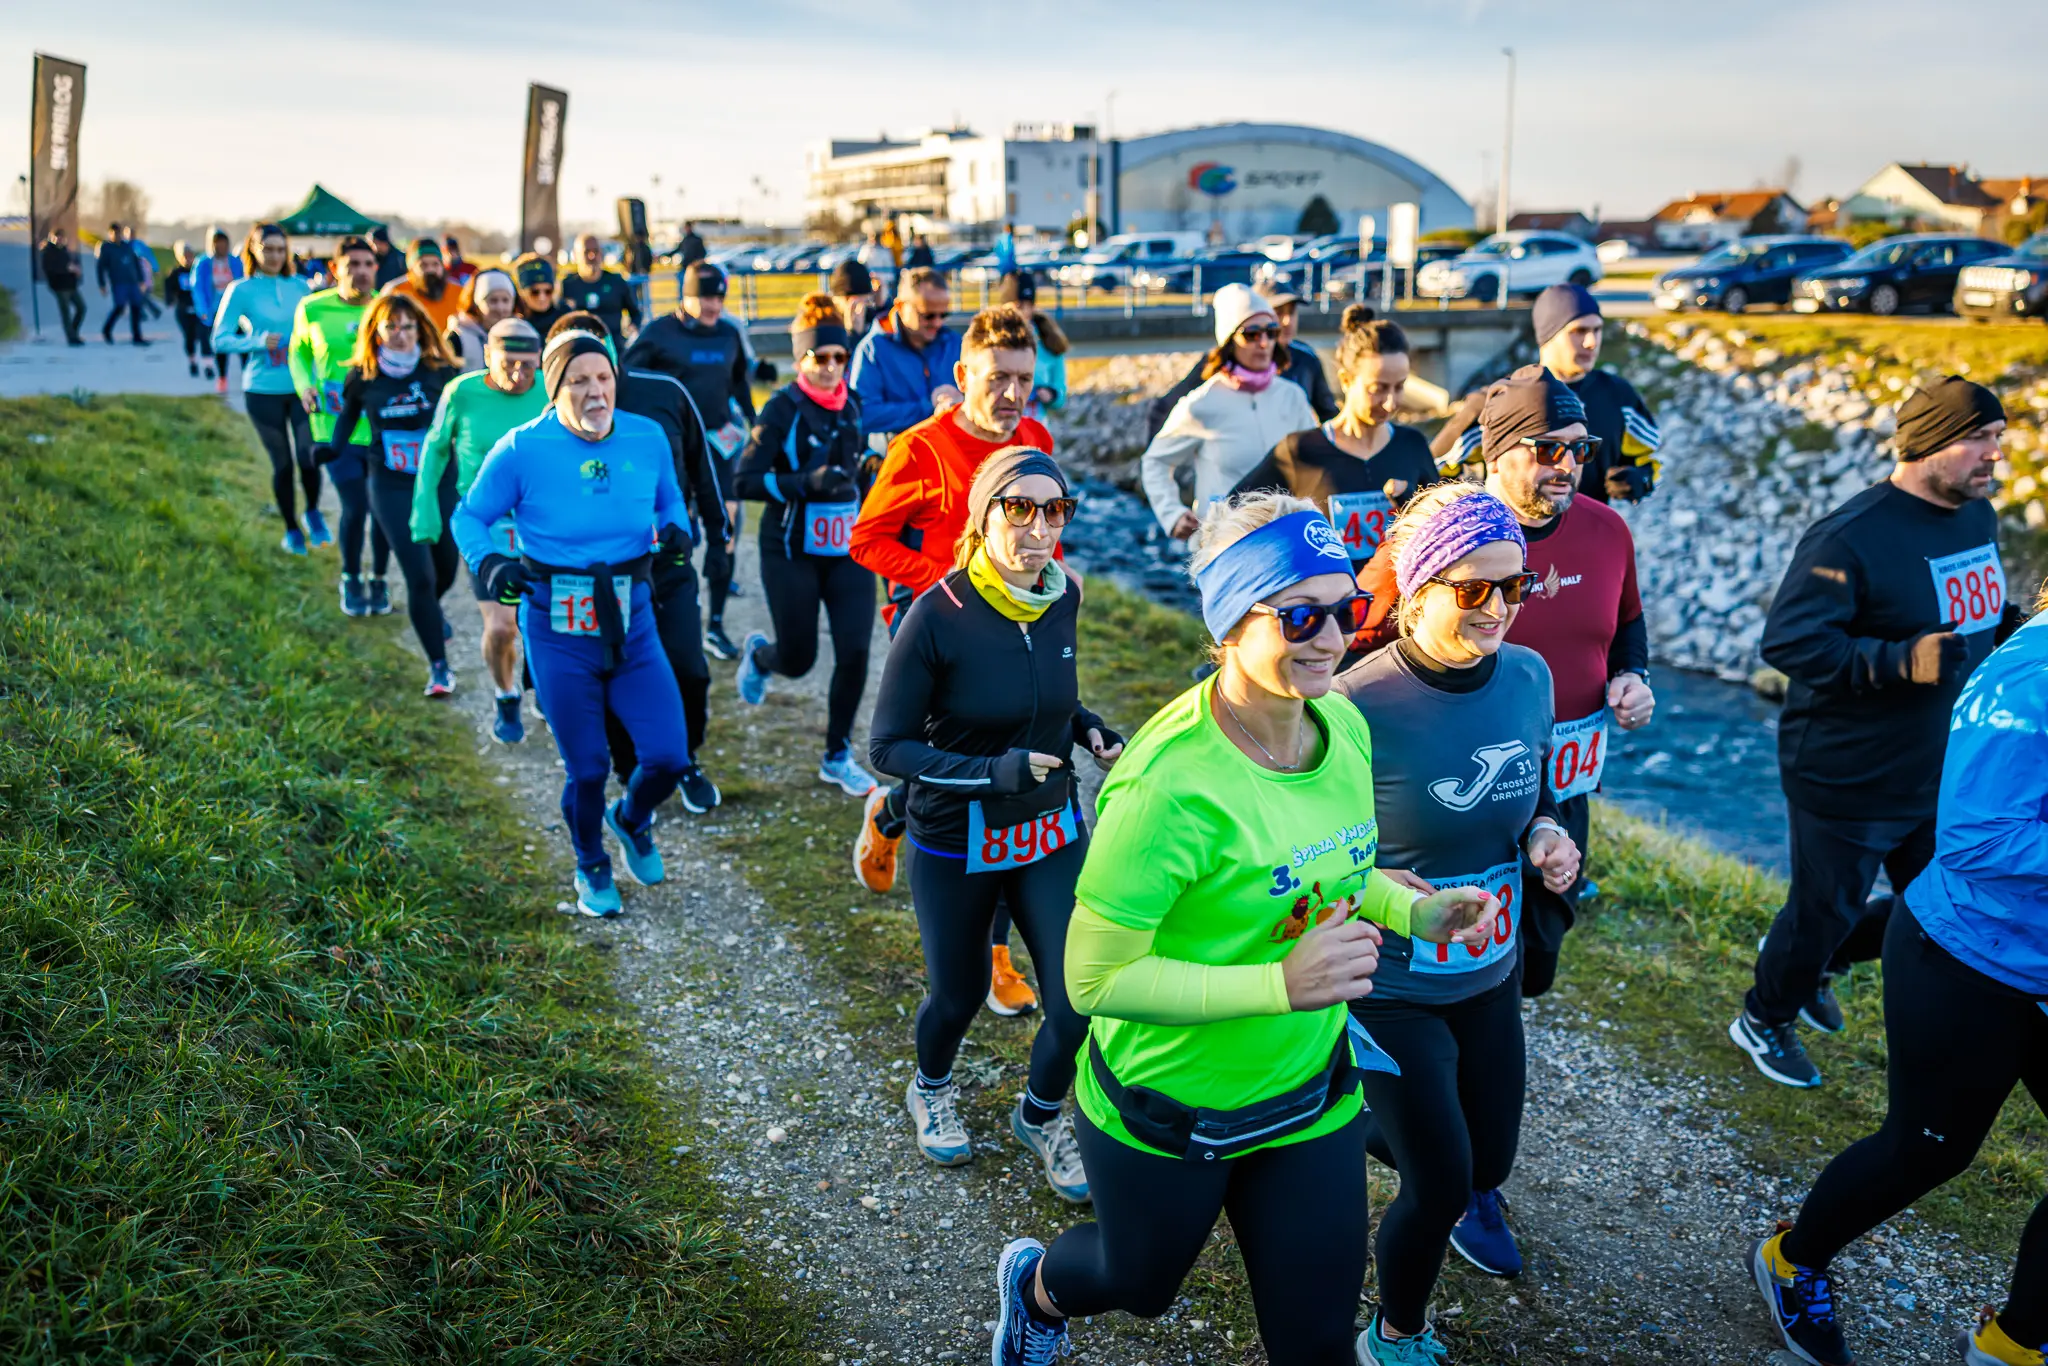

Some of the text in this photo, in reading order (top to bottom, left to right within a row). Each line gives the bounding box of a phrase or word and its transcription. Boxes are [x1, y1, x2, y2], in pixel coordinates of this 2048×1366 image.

[1560, 574, 1582, 587] HALF
[1945, 565, 2000, 626] 886
[560, 594, 621, 632] 13
[1556, 724, 1576, 736] LIGA
[1517, 759, 1536, 775] 31.
[1548, 731, 1600, 790] 04
[1496, 778, 1525, 791] CROSS
[1491, 788, 1523, 802] DRAVA
[981, 812, 1066, 864] 898
[1268, 864, 1302, 897] 3.
[1430, 882, 1458, 891] ROS
